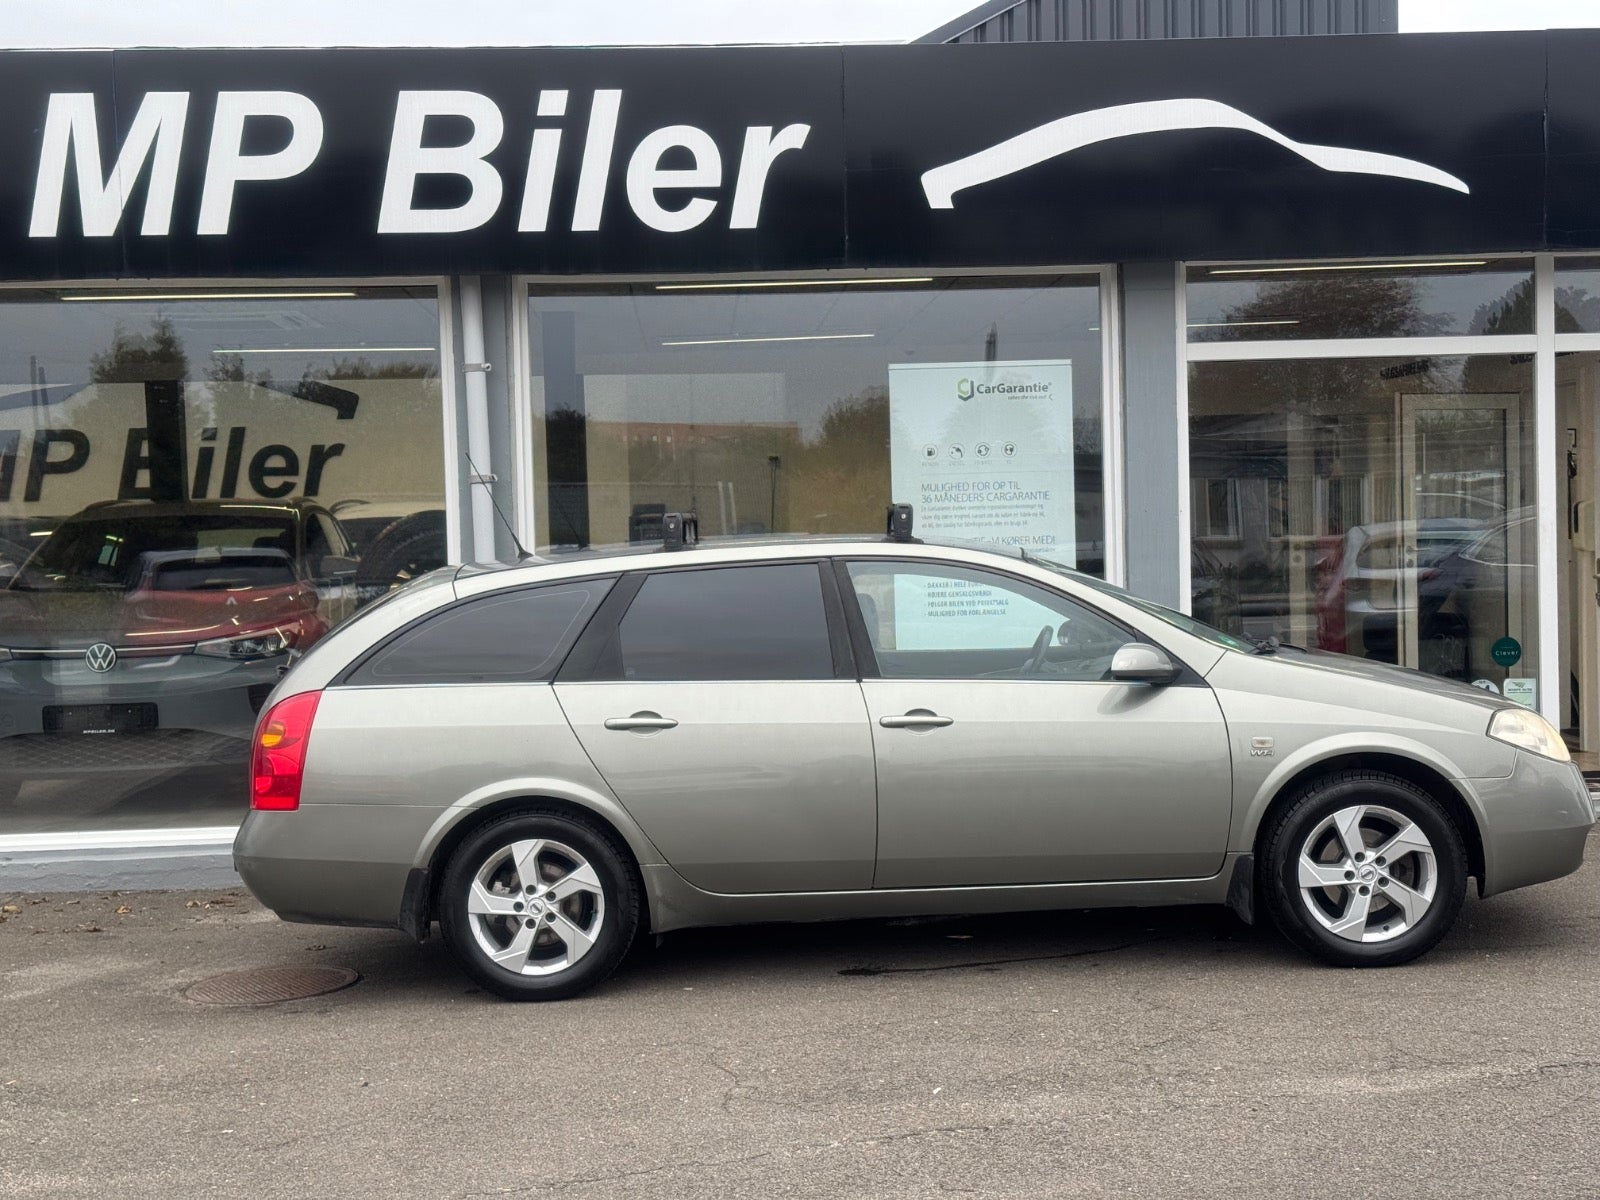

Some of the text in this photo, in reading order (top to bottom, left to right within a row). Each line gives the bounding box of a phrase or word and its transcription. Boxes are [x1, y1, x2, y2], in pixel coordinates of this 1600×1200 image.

[27, 88, 812, 238] MP Biler
[921, 480, 1021, 493] MULIGHED FOR OP TIL
[921, 490, 1050, 504] 36 MÅNEDERS CARGARANTIE
[1001, 535, 1030, 546] KØRER
[1032, 534, 1056, 545] MED!
